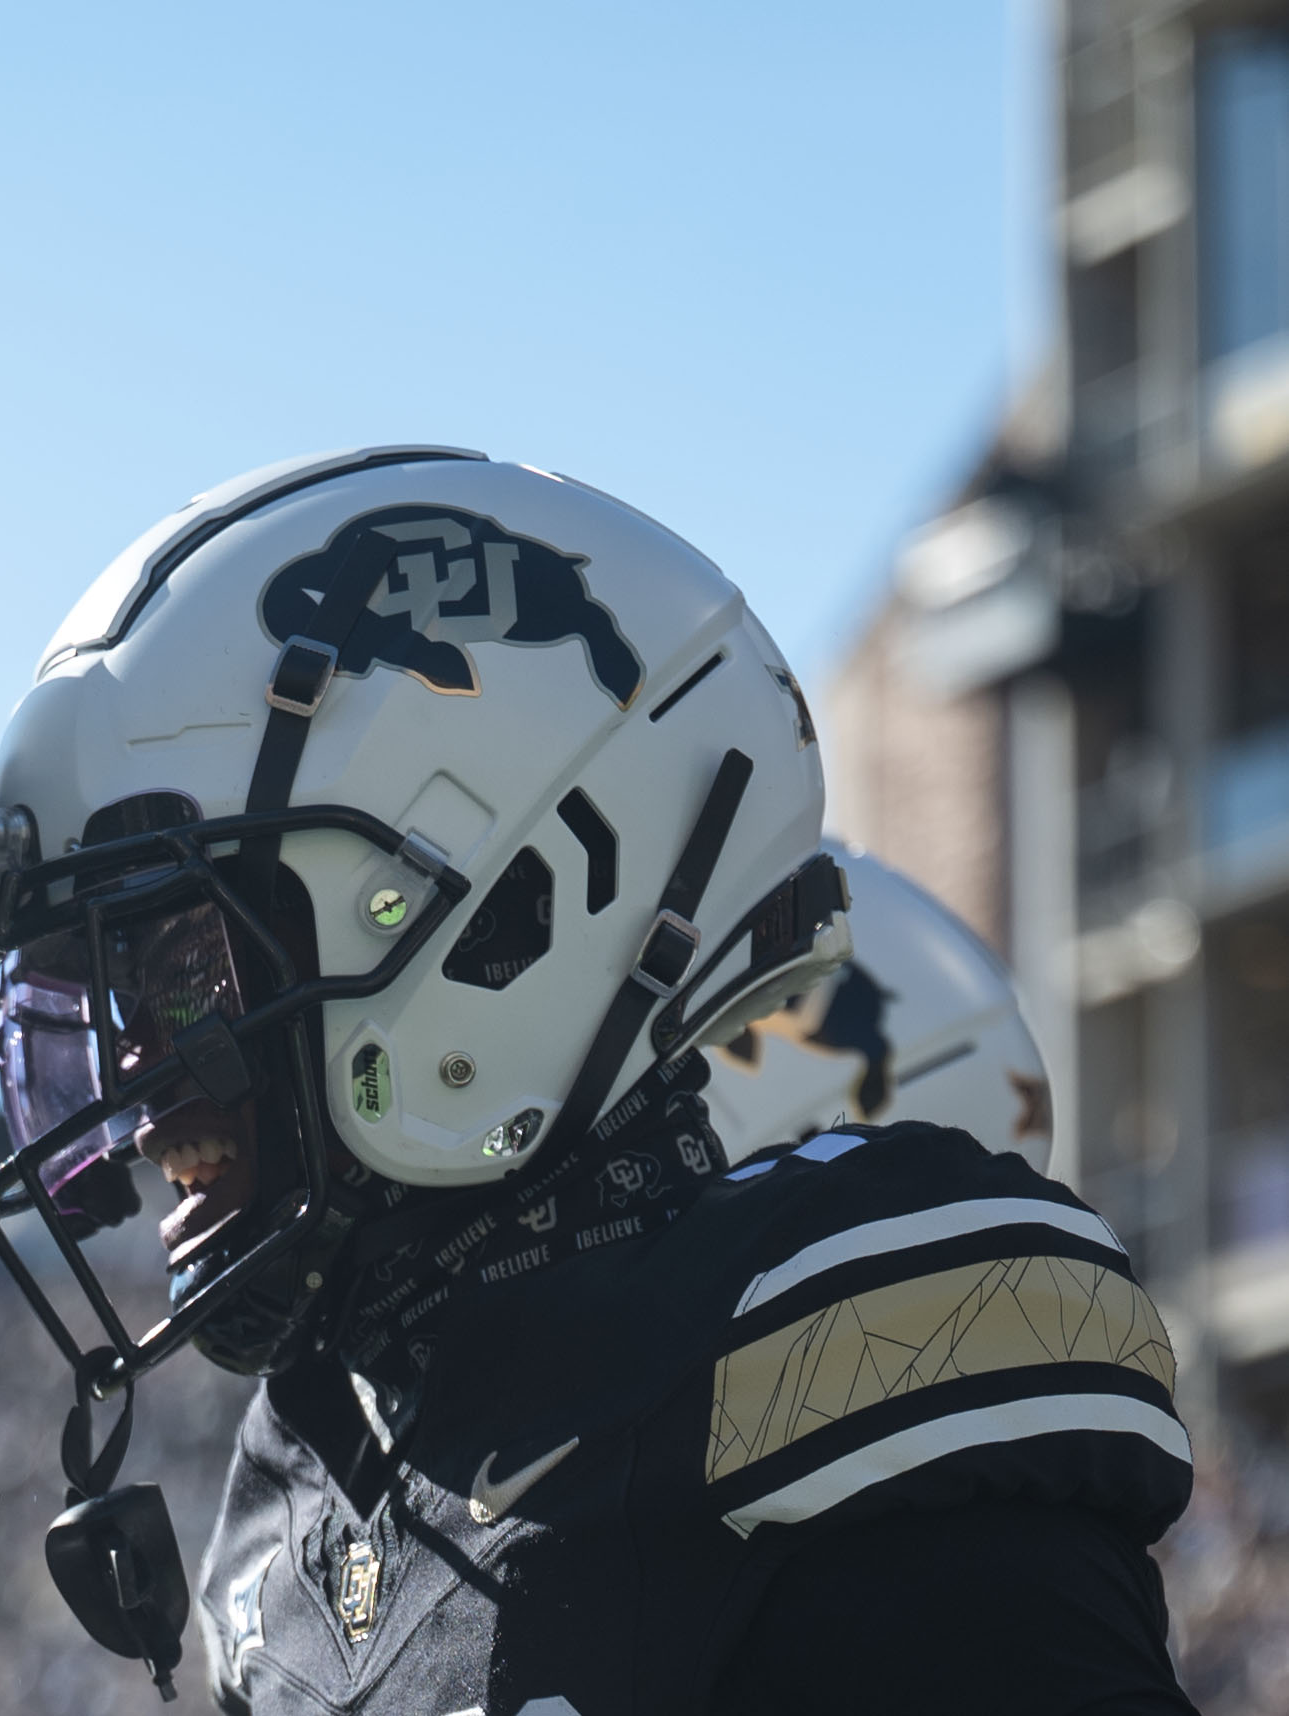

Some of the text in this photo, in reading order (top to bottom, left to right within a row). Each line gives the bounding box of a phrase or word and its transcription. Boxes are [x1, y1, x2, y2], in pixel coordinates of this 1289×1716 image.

[366, 518, 520, 643] CU
[361, 1049, 380, 1112] schu
[606, 1158, 645, 1192] CU
[676, 1133, 712, 1175] CU
[575, 1215, 644, 1251] IBELIEVE
